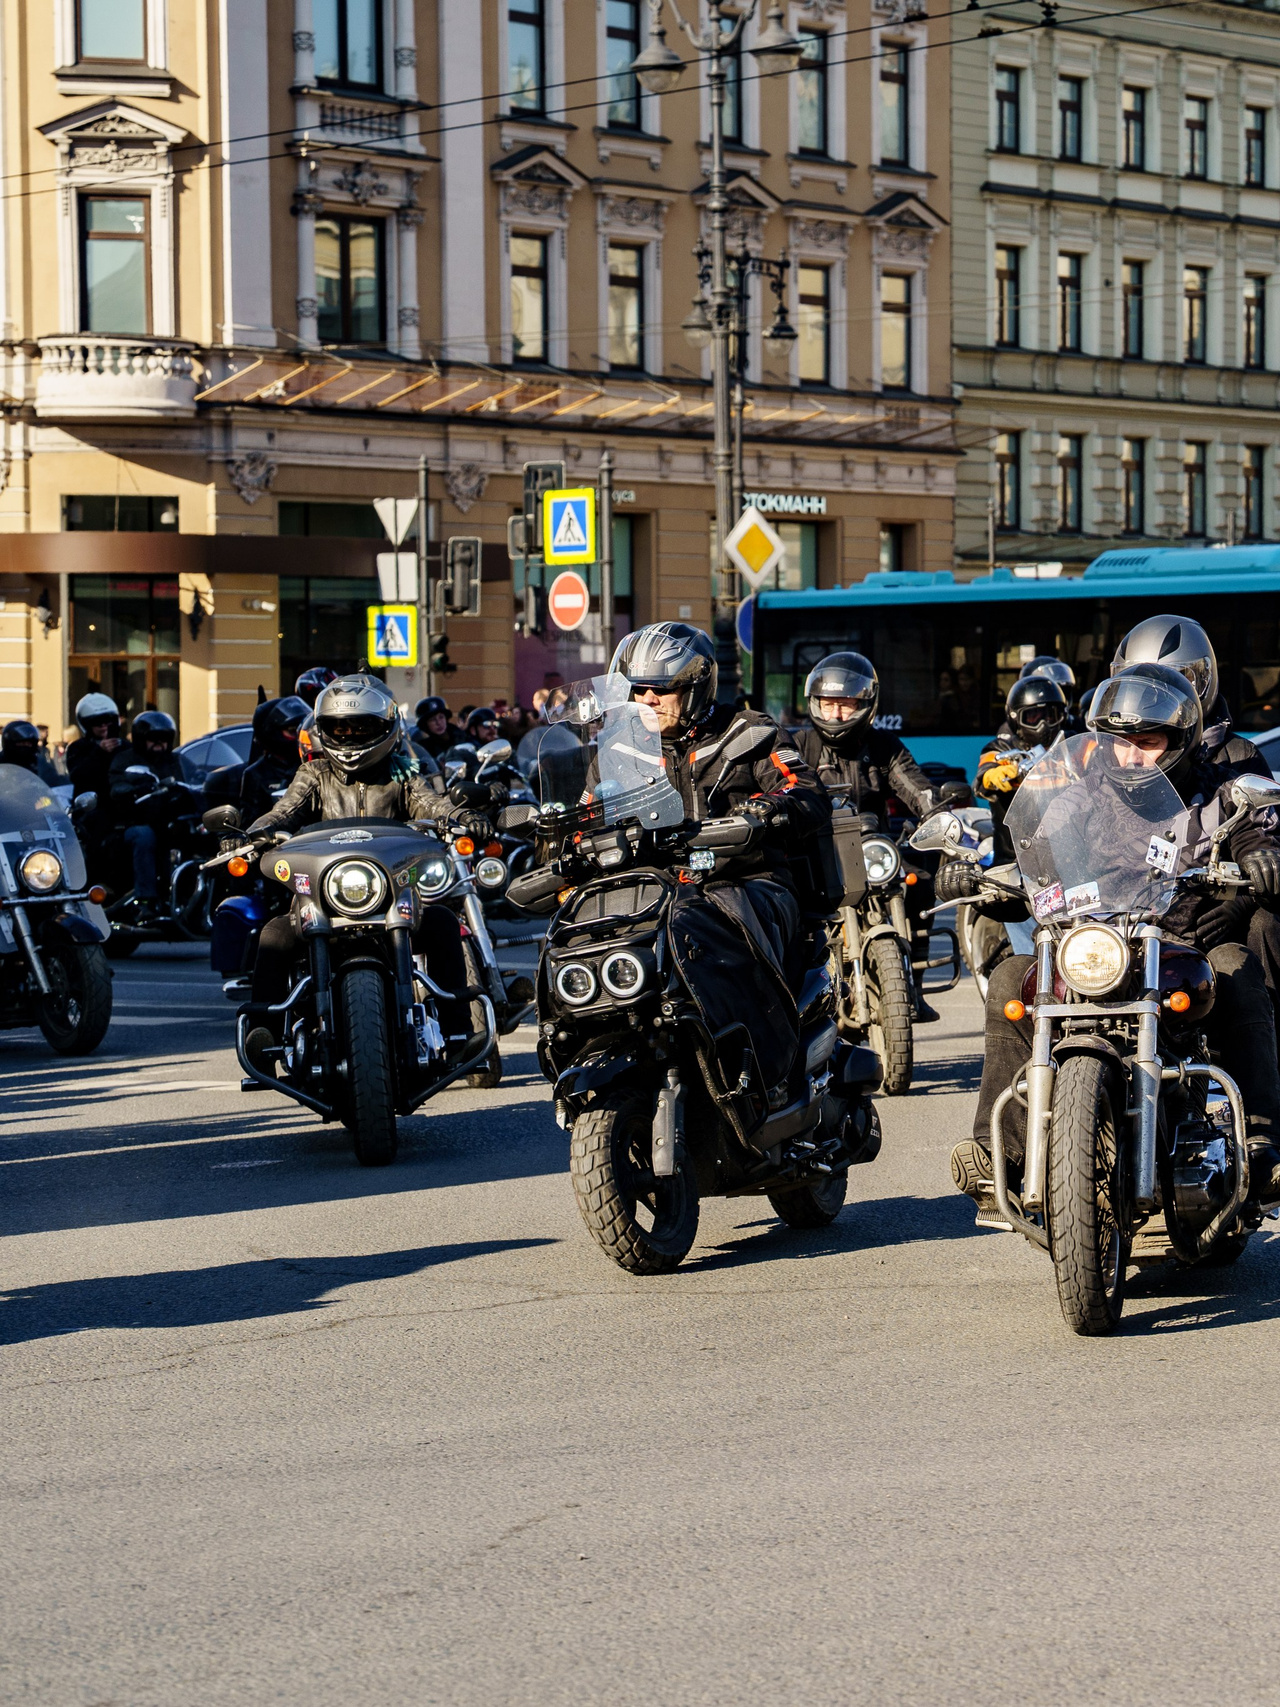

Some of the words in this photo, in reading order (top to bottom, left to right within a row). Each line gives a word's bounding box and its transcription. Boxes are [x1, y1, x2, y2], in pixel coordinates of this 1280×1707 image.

[821, 682, 845, 692] LAZER
[335, 700, 357, 708] SHOEI
[872, 714, 903, 730] 6422
